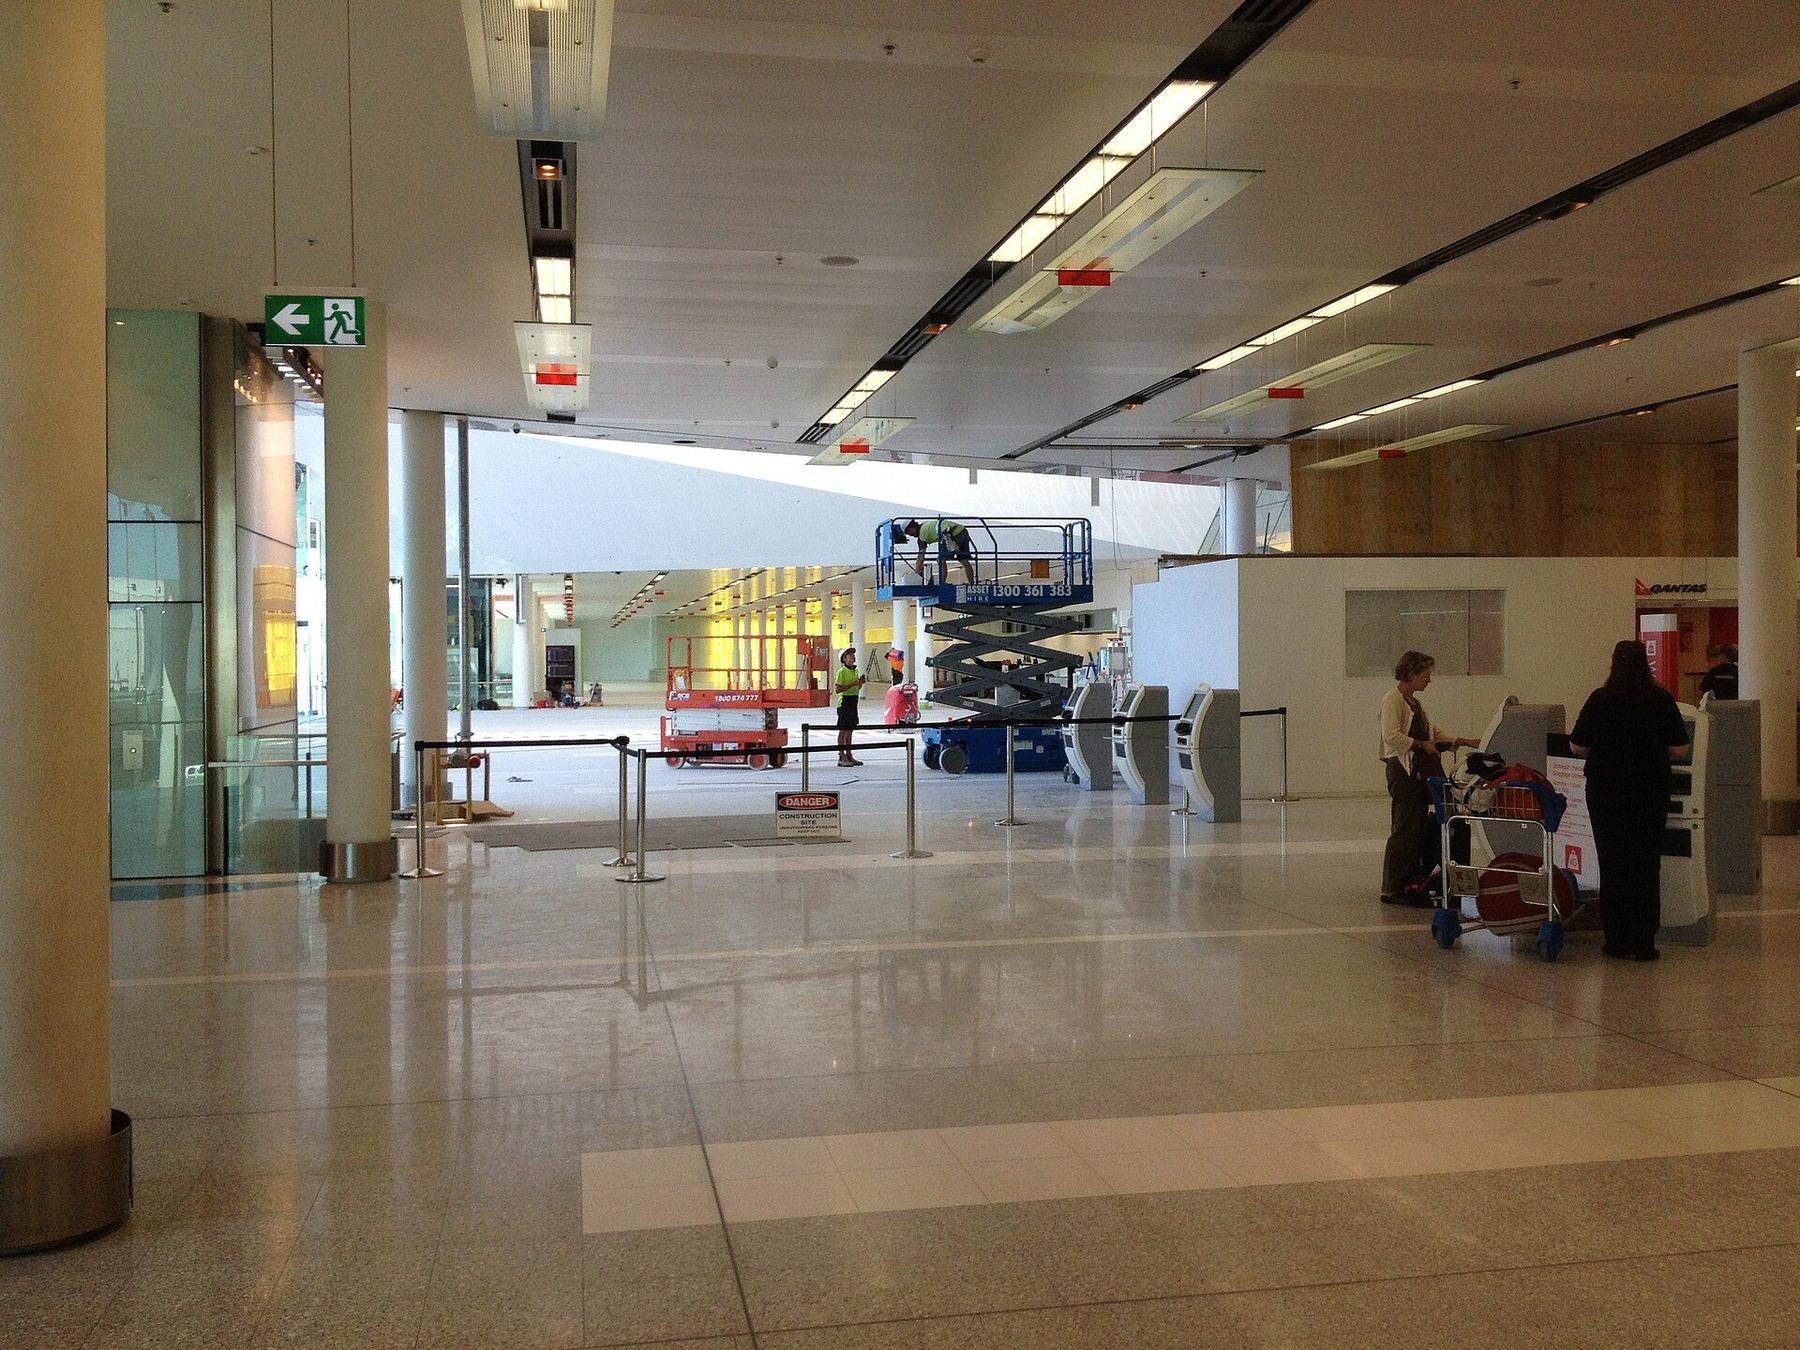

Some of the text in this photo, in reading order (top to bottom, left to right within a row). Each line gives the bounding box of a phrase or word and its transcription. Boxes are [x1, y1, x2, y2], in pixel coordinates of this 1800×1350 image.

[967, 585, 989, 594] ASSET
[993, 585, 1072, 597] 1300 361 383
[1651, 583, 1707, 593] QANTAS
[786, 797, 830, 806] DANGER
